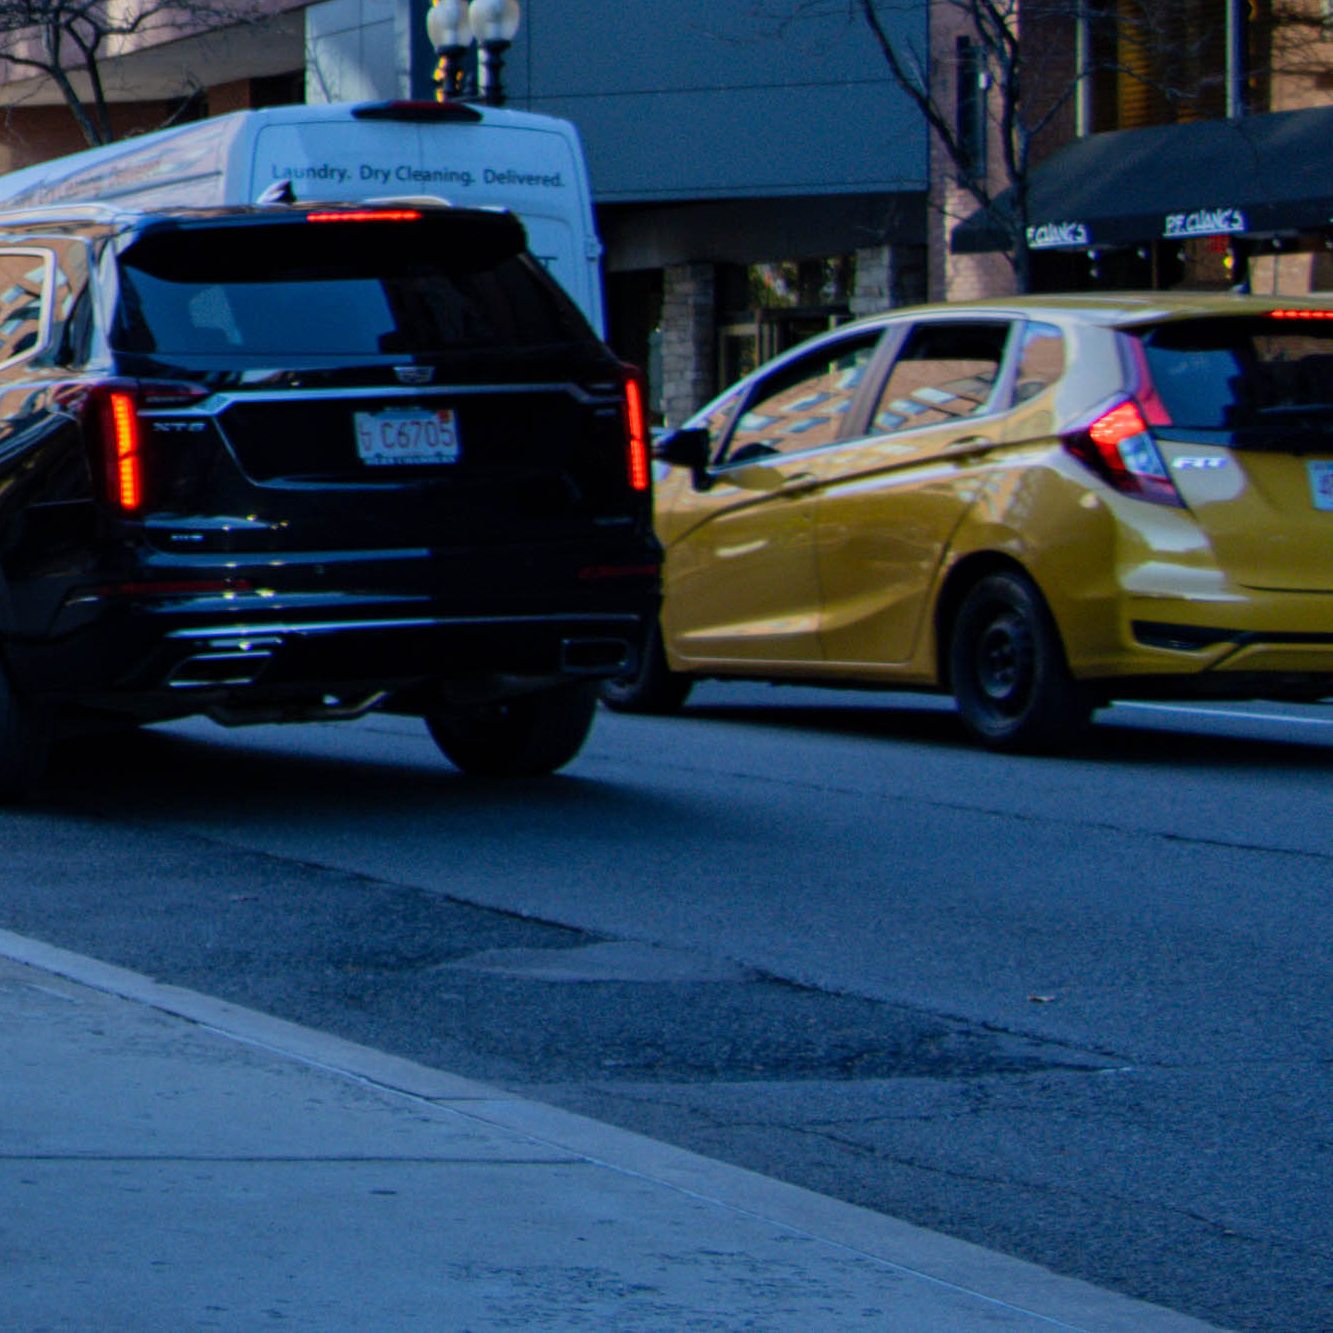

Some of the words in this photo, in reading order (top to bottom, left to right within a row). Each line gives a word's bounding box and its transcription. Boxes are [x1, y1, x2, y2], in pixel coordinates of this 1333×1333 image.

[272, 165, 351, 184] Laundry.
[359, 165, 391, 184] Dry
[396, 166, 475, 186] Cleaning.
[483, 168, 565, 187] Delivered.
